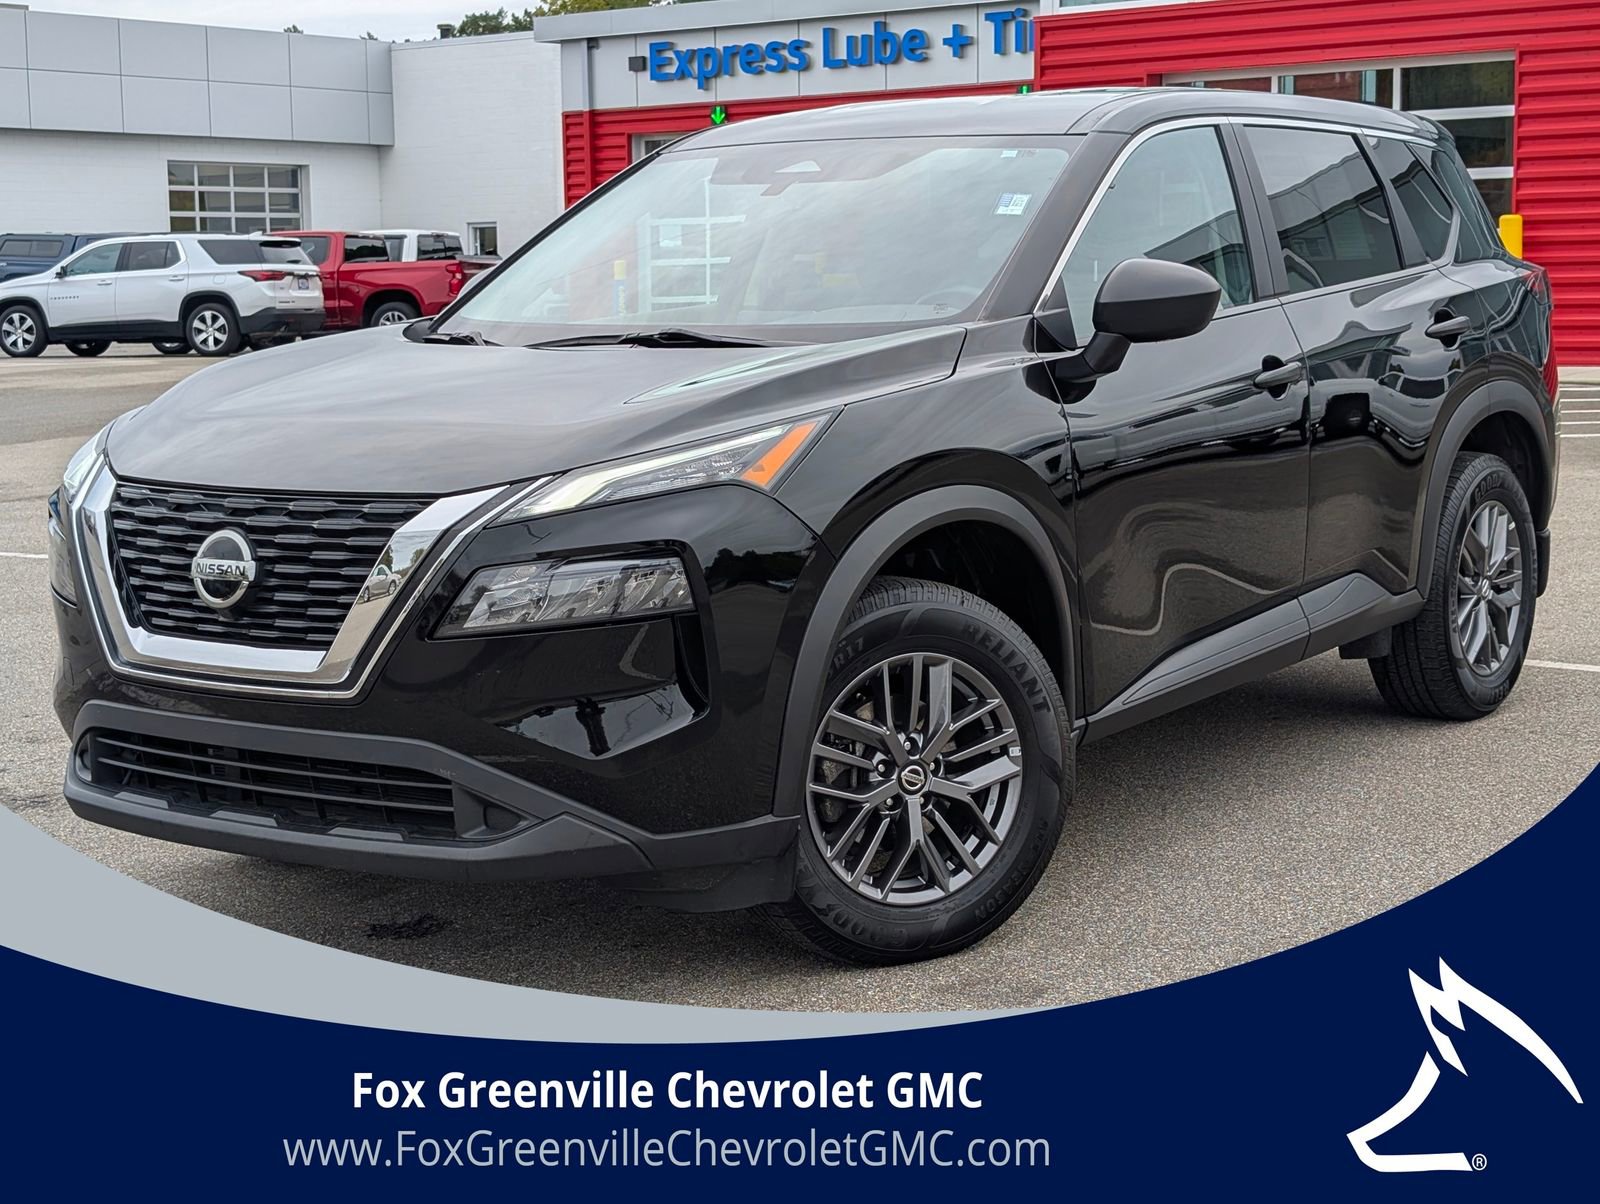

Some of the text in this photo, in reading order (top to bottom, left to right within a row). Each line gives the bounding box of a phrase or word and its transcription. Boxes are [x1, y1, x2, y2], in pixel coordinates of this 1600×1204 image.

[649, 38, 811, 90] Express
[822, 20, 928, 70] Lube
[196, 562, 246, 577] NISSAN
[962, 621, 1052, 715] RELIANT
